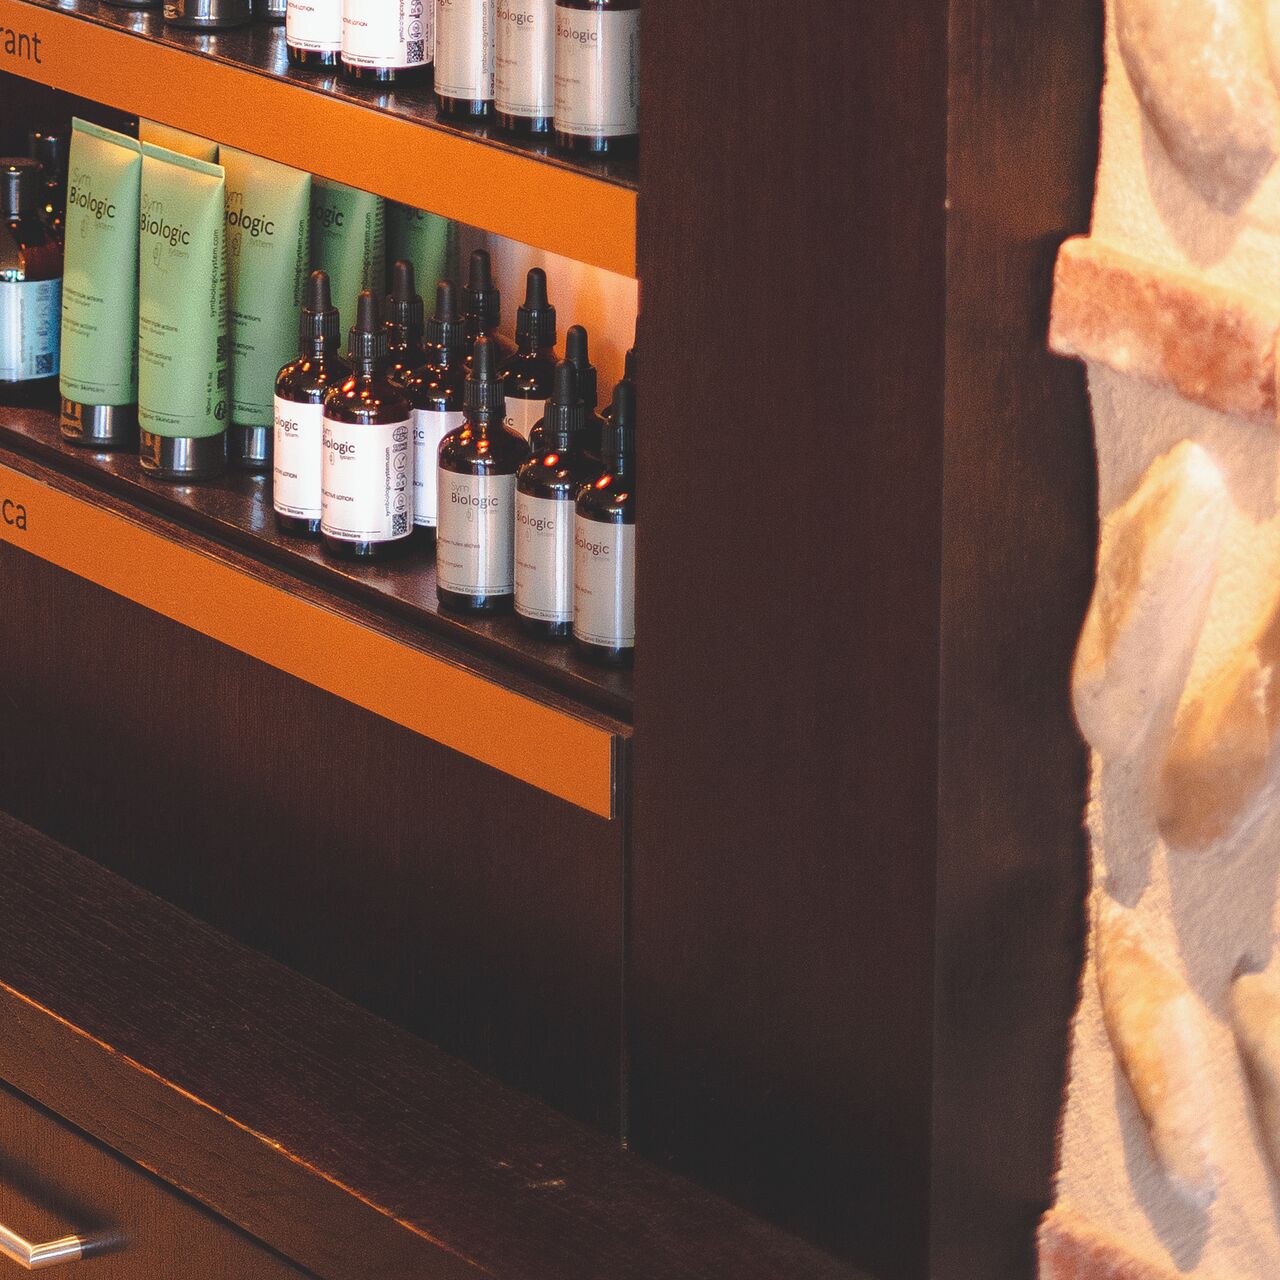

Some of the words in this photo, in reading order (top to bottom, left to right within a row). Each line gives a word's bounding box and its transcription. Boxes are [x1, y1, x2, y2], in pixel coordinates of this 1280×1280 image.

[69, 185, 116, 221] Biologic
[140, 211, 190, 247] Biologic
[209, 228, 220, 319] symbiologicsystem.com
[450, 480, 469, 494] Sym
[451, 492, 499, 510] Biologic
